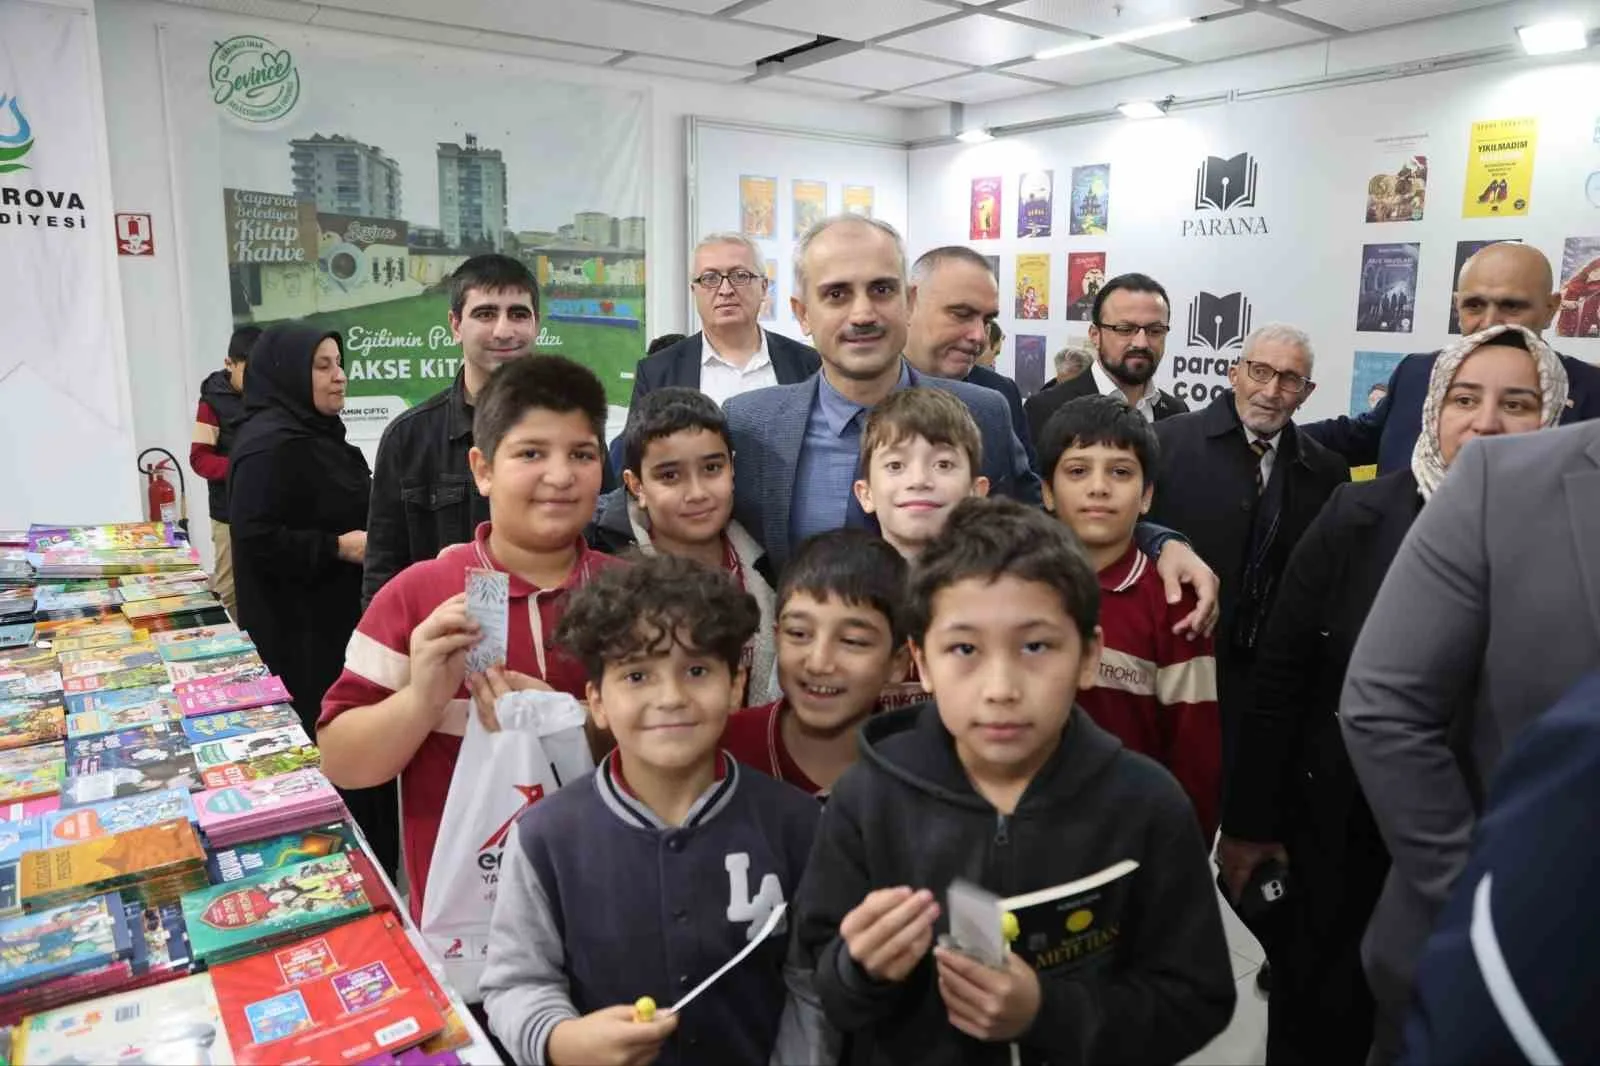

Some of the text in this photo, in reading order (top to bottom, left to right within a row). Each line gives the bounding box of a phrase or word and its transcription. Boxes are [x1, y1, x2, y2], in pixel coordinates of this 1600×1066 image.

[214, 57, 291, 104] Sevince
[1477, 140, 1529, 153] YIKILMADIM
[2, 187, 85, 210] ROVA
[0, 211, 86, 228] DİYESİ
[1182, 216, 1269, 237] PARANA
[235, 219, 299, 247] Kitap
[233, 241, 305, 262] Kahve
[347, 326, 423, 356] Eğitimin
[428, 325, 460, 349] Pa
[350, 357, 464, 380] AKSE KİT
[1173, 355, 1240, 378] para
